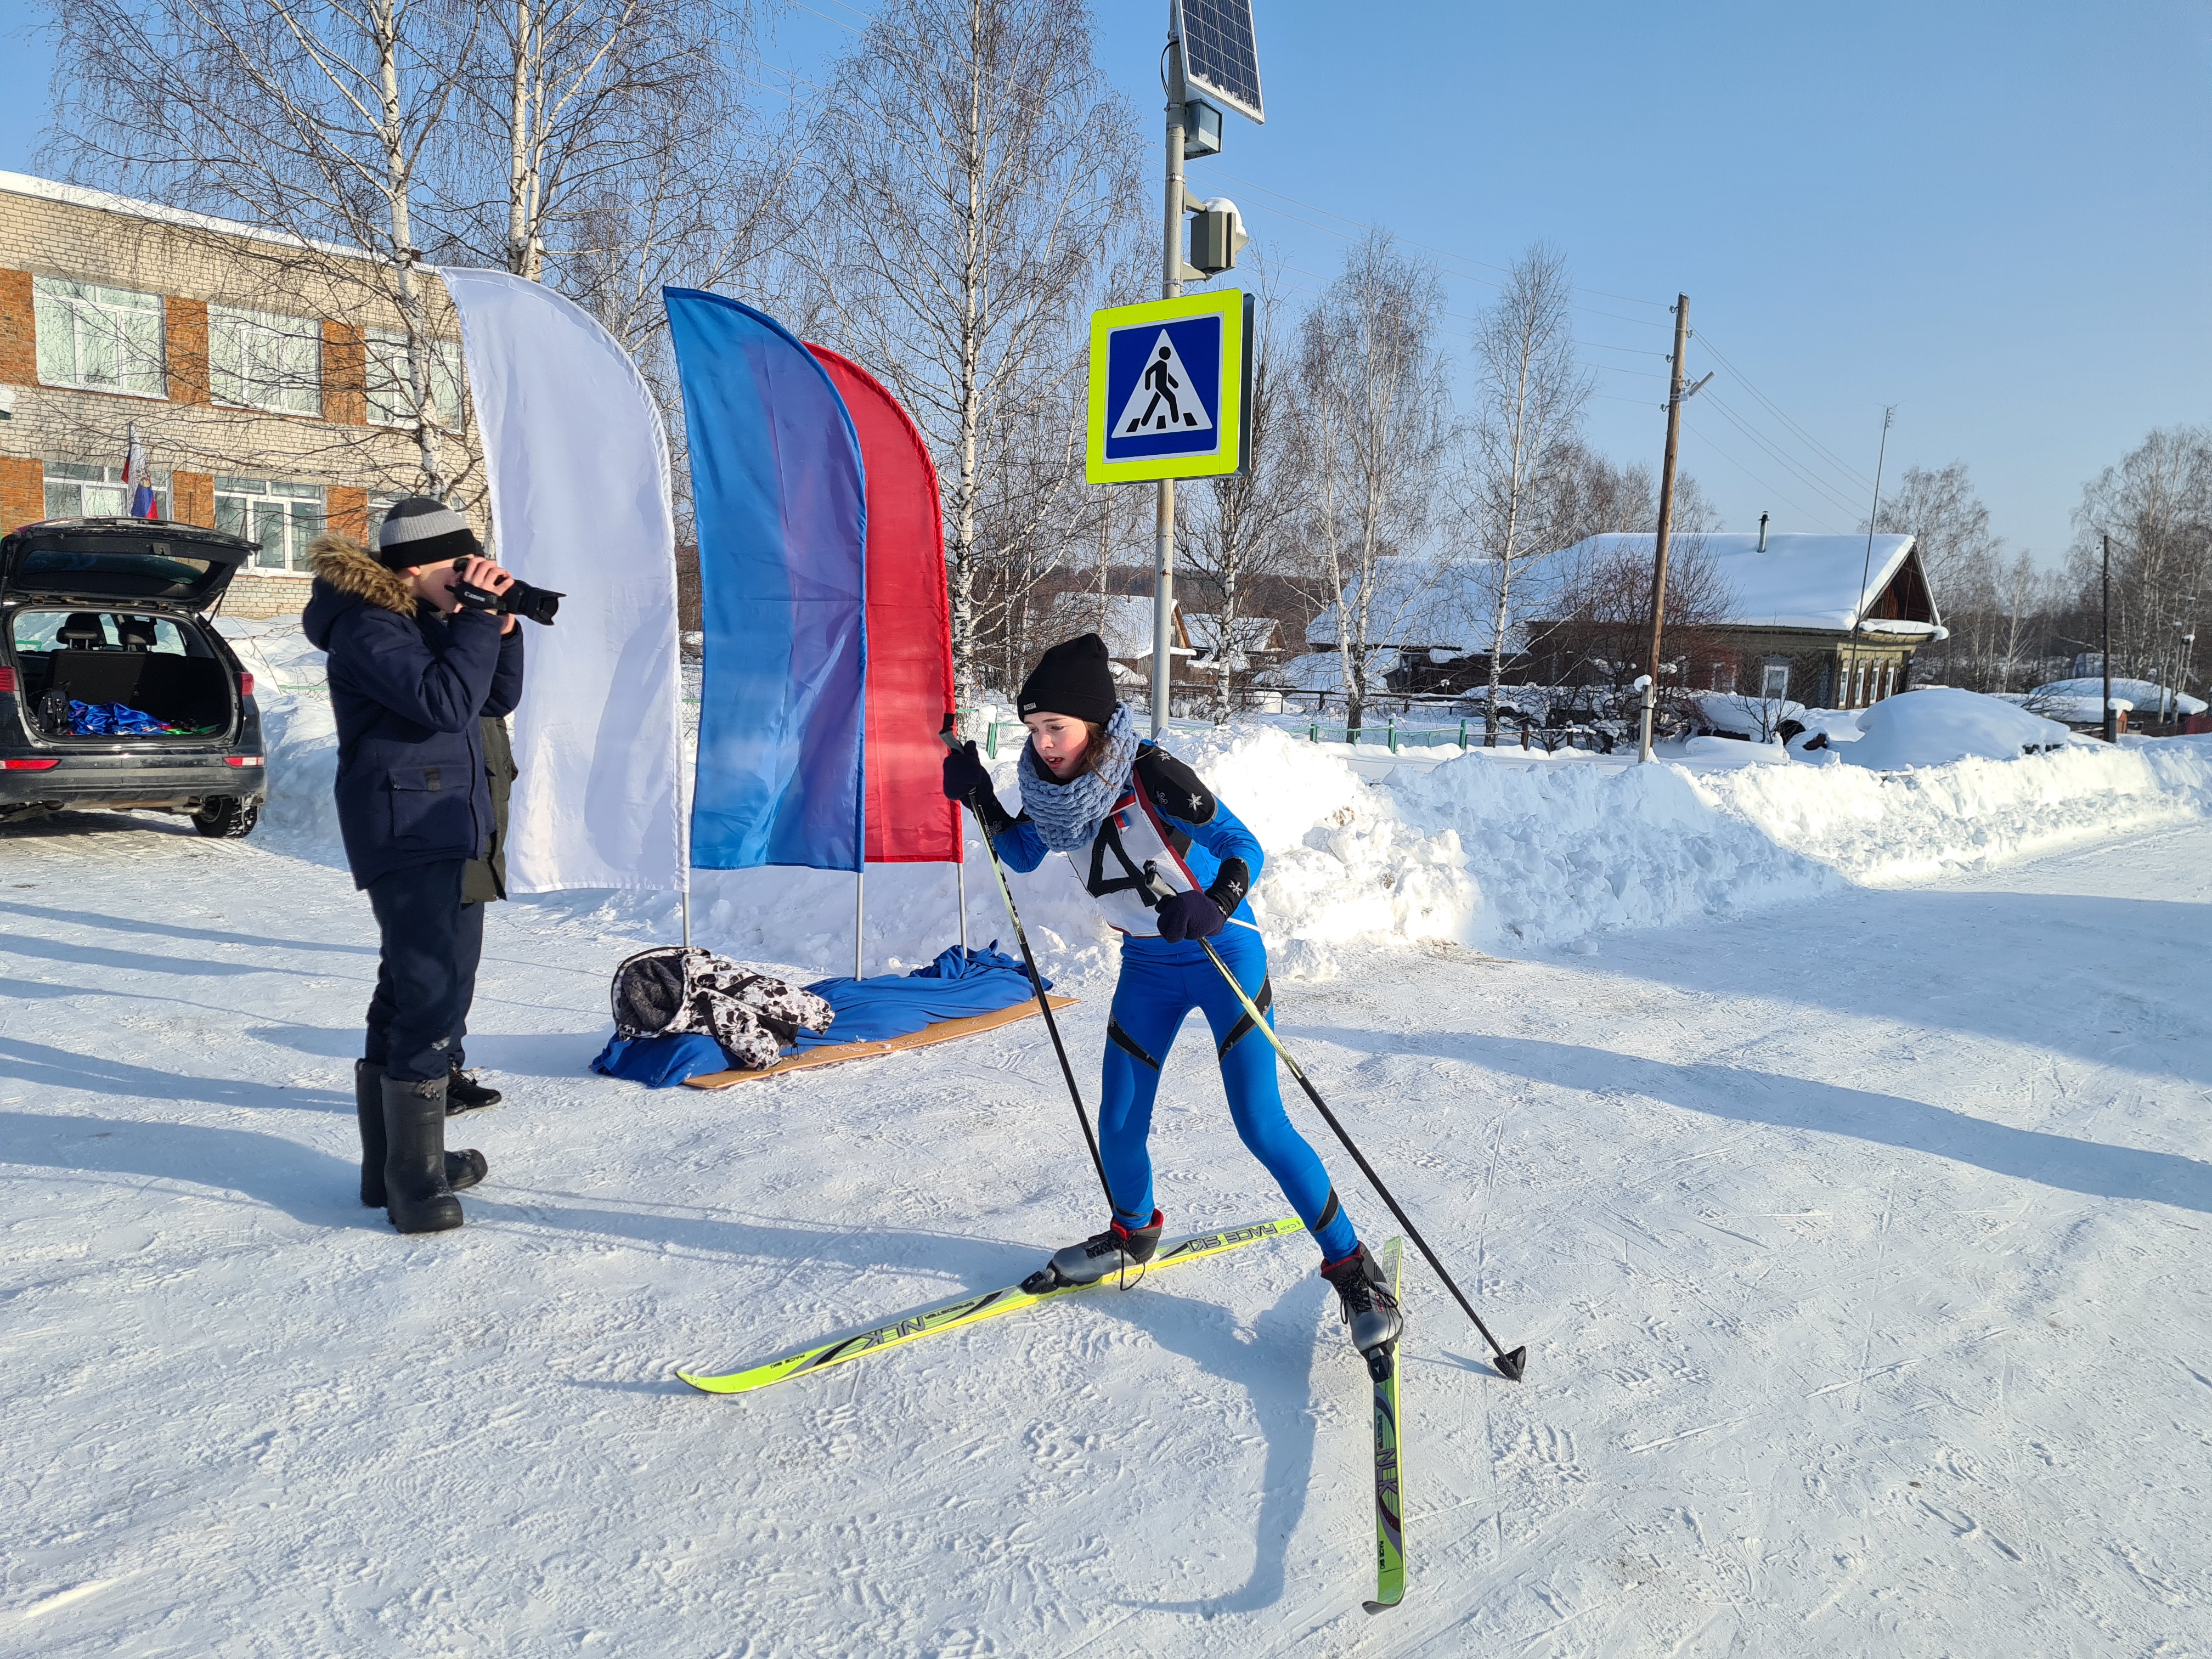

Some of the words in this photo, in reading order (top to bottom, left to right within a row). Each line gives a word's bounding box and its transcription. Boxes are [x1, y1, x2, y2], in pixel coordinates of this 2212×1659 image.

[1087, 814, 1158, 908] 4
[1187, 1235, 1222, 1252] SKI
[1223, 1223, 1279, 1244] RACE
[924, 1301, 975, 1319] SPEEDSTER
[860, 1316, 926, 1350] NLK
[785, 1353, 805, 1364] RACE
[1376, 1448, 1398, 1498] NLK
